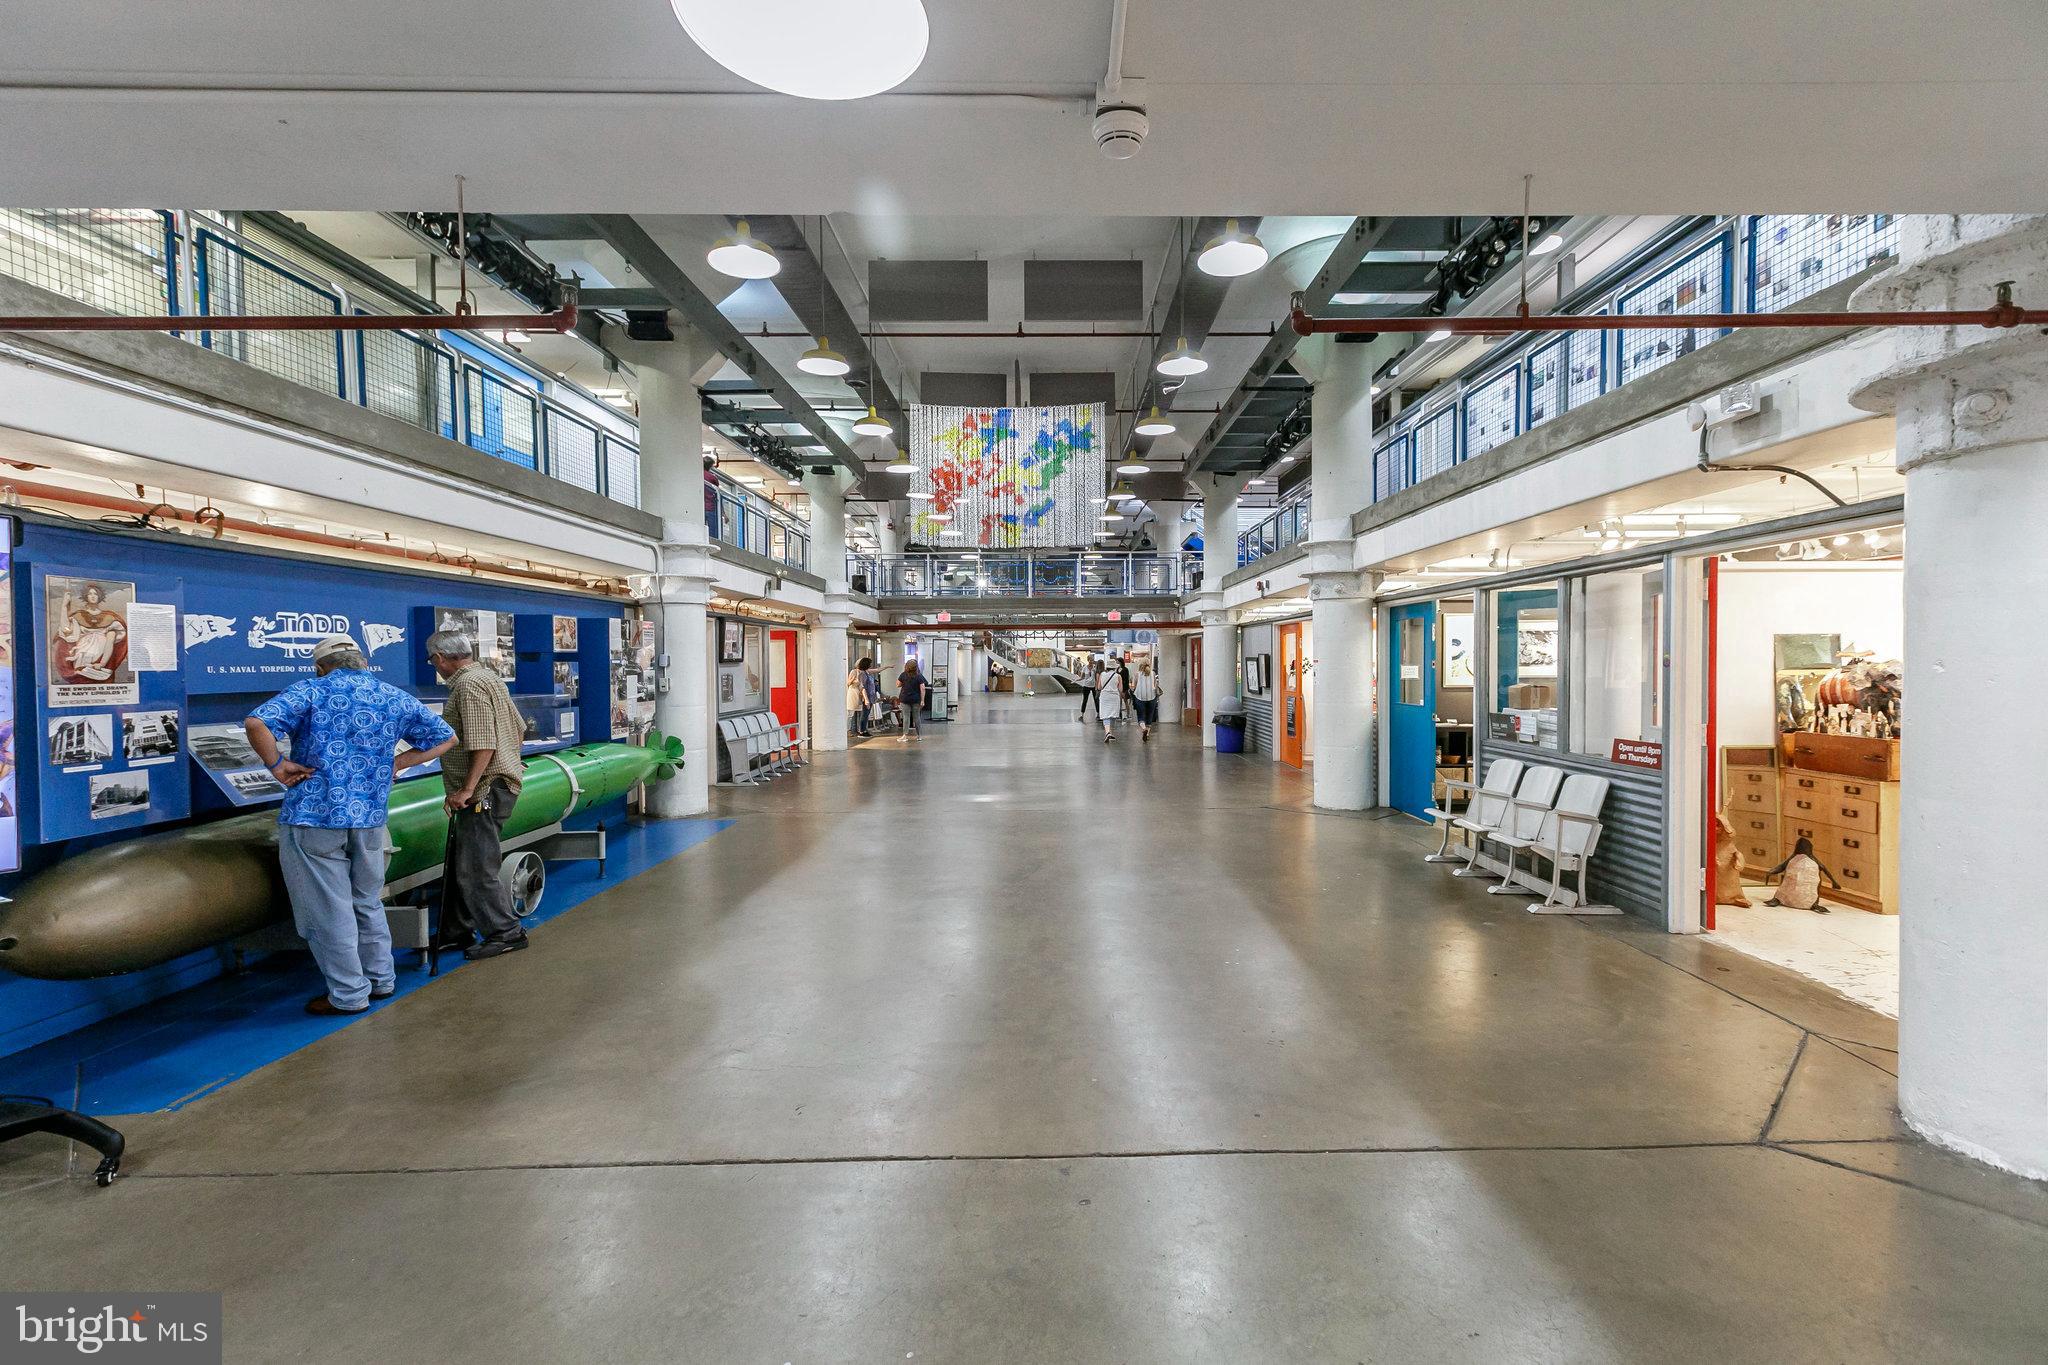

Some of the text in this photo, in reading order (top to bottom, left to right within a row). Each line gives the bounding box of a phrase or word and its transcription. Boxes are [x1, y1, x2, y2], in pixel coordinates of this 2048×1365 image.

[251, 615, 276, 631] The
[207, 666, 216, 674] U.
[219, 665, 228, 673] S.
[229, 665, 257, 673] NAVAL
[260, 665, 295, 673] TORPEDO
[1618, 742, 1662, 756] Open until 9pm
[1627, 752, 1658, 765] Thursdays
